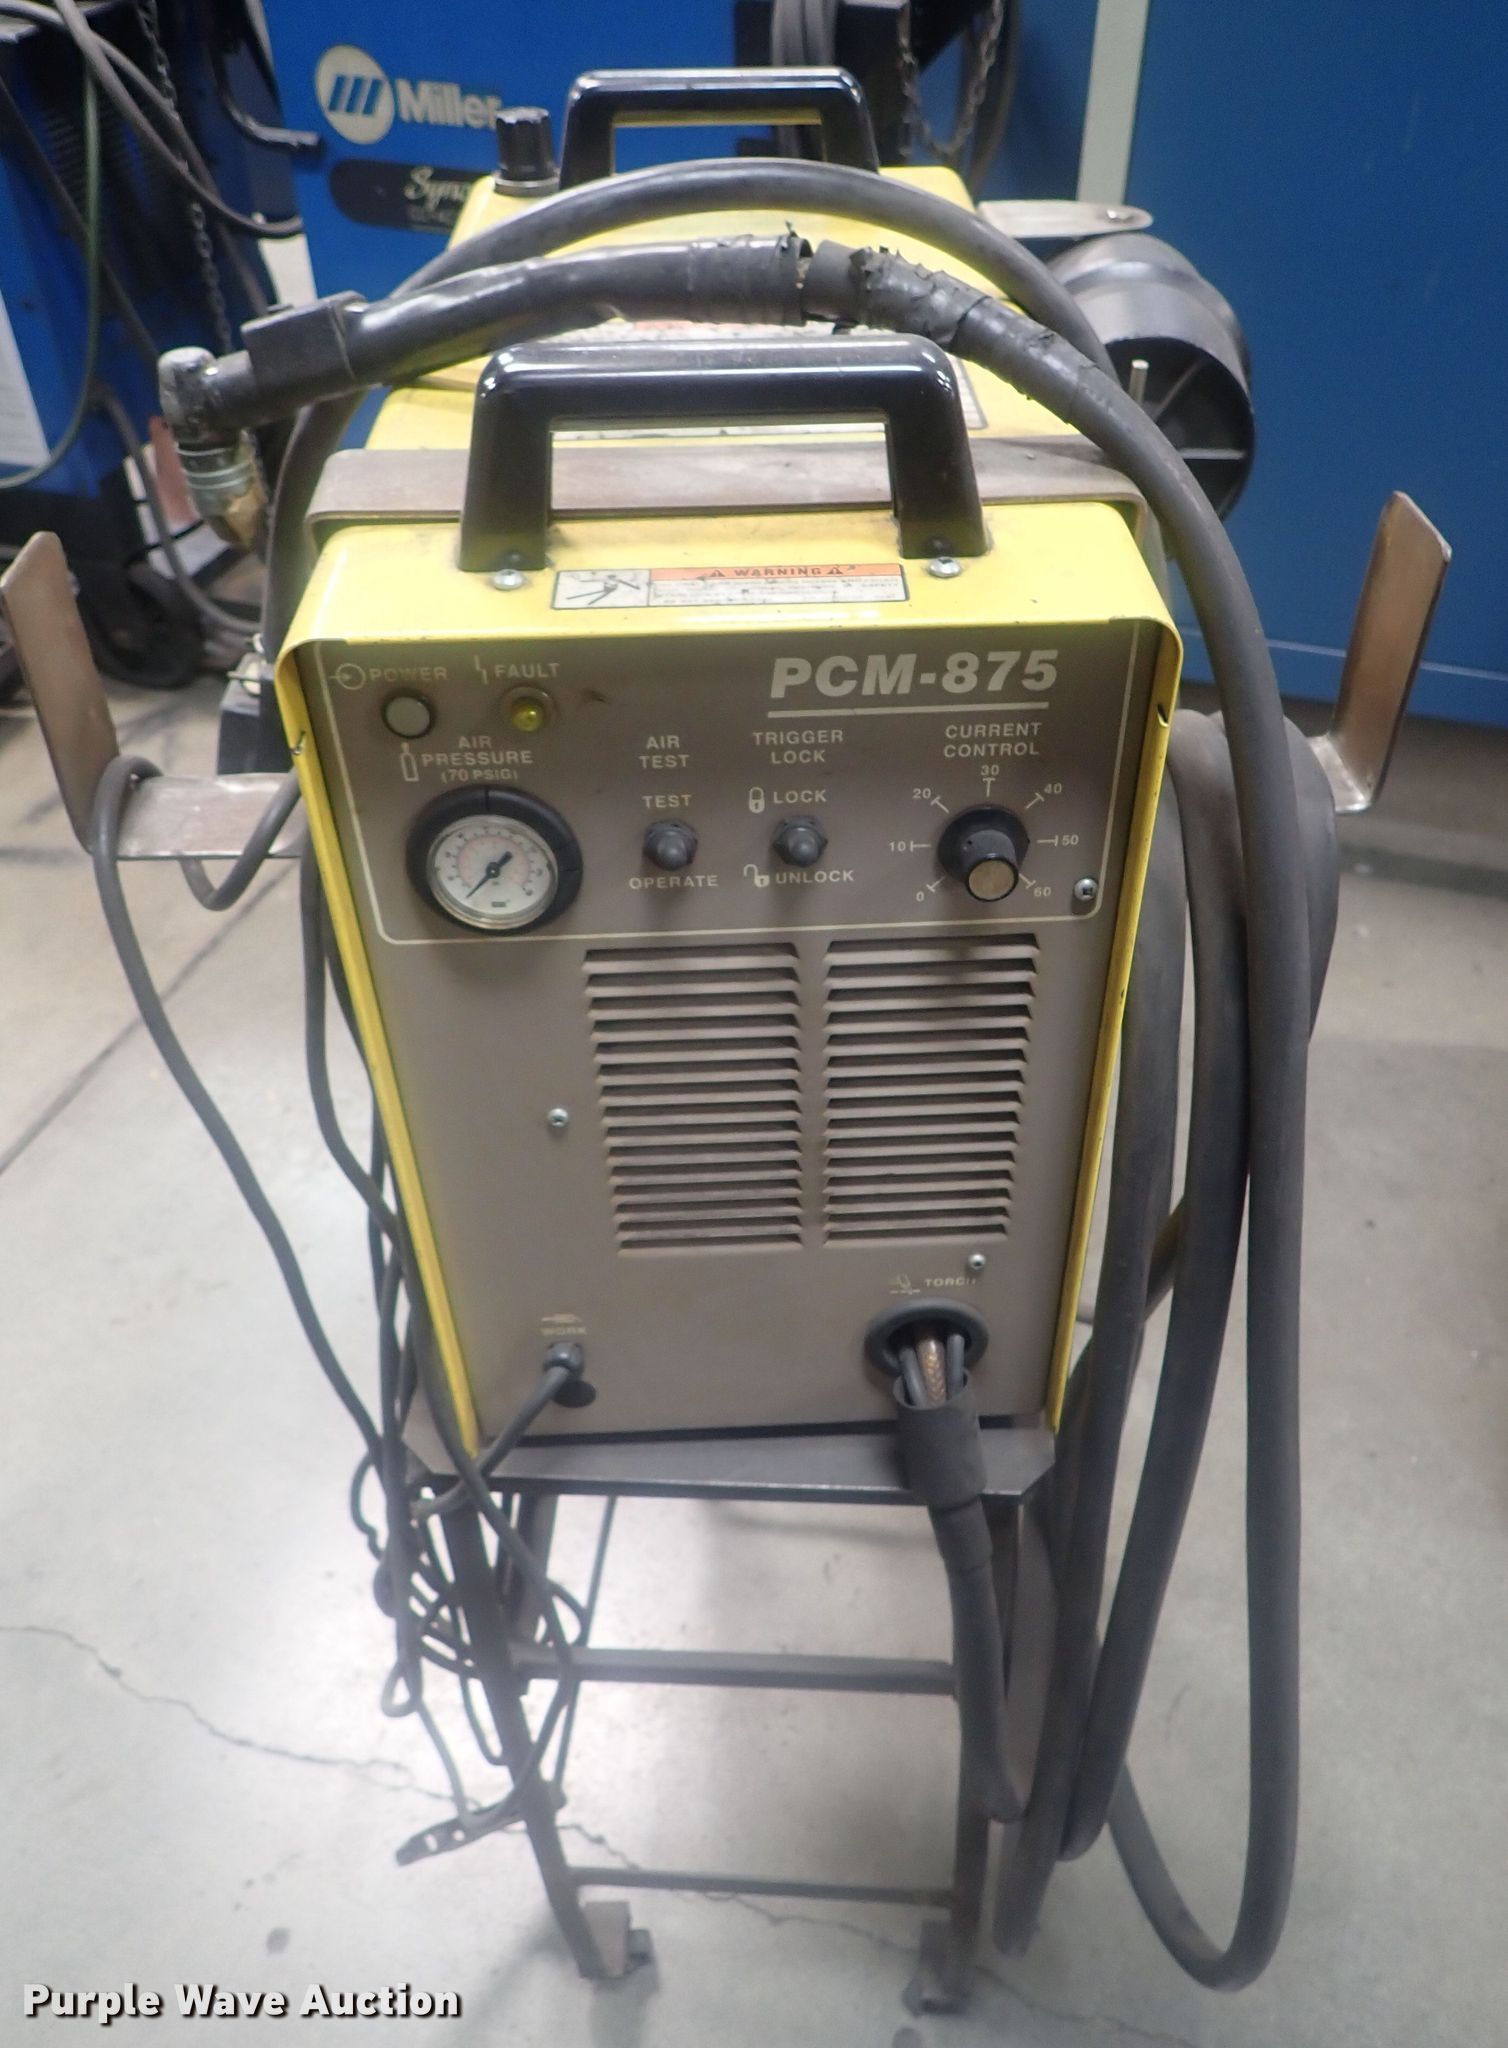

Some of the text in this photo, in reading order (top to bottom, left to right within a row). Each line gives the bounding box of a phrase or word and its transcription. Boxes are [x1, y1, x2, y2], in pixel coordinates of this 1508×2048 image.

[396, 78, 502, 130] Miller
[734, 567, 822, 577] WARNING
[368, 666, 448, 682] POWER
[494, 662, 560, 679] FAULT
[770, 649, 1059, 699] PCM-875
[752, 729, 843, 746] TRIGGER
[945, 722, 1042, 739] CURRENT
[458, 735, 492, 749] AIR
[646, 735, 680, 749] AIR
[421, 750, 534, 766] PRESSURE
[771, 749, 827, 765] LOCK
[943, 742, 1040, 759] CONTROL
[639, 754, 690, 769] TEST
[441, 768, 519, 782] (70 PSIG)
[980, 764, 1000, 776] 30
[773, 789, 827, 804] LOCK
[912, 788, 932, 799] 20
[1044, 783, 1063, 795] 40
[642, 794, 692, 809] TEST
[889, 841, 906, 851] 10
[1062, 835, 1080, 846] 50
[628, 874, 719, 890] OPERATE
[775, 870, 854, 885] UNLOCK
[915, 891, 925, 902] 0
[1033, 887, 1052, 897] 60
